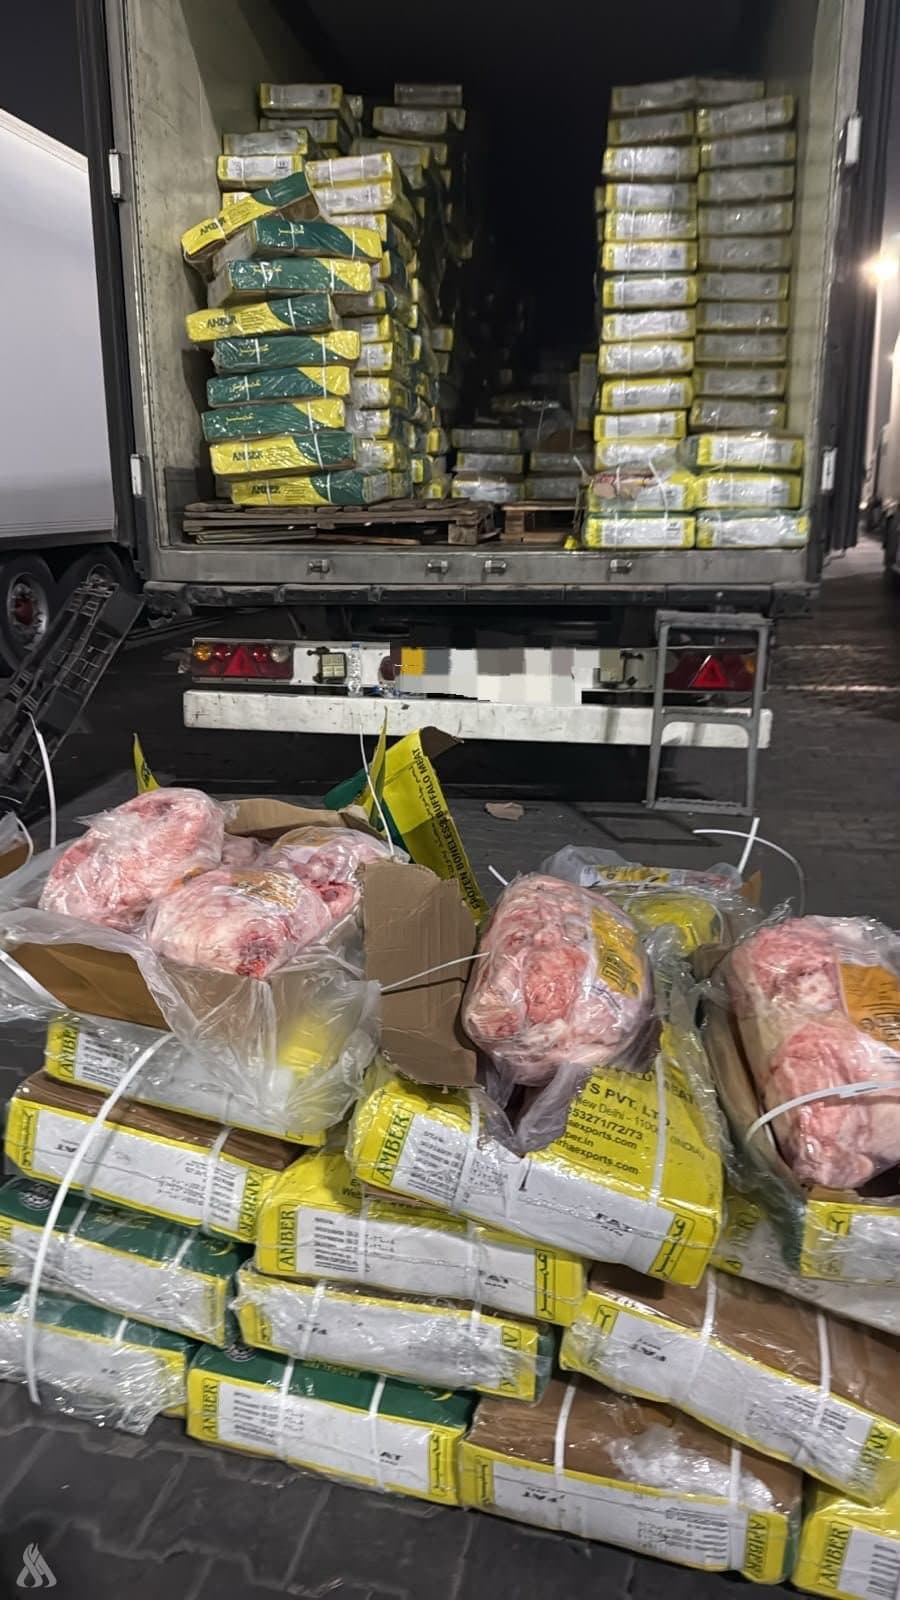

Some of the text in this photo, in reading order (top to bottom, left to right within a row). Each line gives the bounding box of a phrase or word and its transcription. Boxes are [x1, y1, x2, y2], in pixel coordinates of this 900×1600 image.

[411, 748, 427, 775] MEAT
[422, 776, 444, 818] BUFFALO
[460, 871, 481, 910] FROZEN
[599, 1102, 625, 1121] Delhi
[604, 1088, 638, 1111] PVT.
[377, 1113, 411, 1180] AMBER
[569, 1106, 644, 1141] 53271/72/73
[240, 1177, 262, 1233] AMBER
[279, 1210, 296, 1267] AMBER
[202, 1384, 217, 1434] AMBER
[747, 1521, 766, 1577] AMBER
[818, 1527, 849, 1585] AMBER
